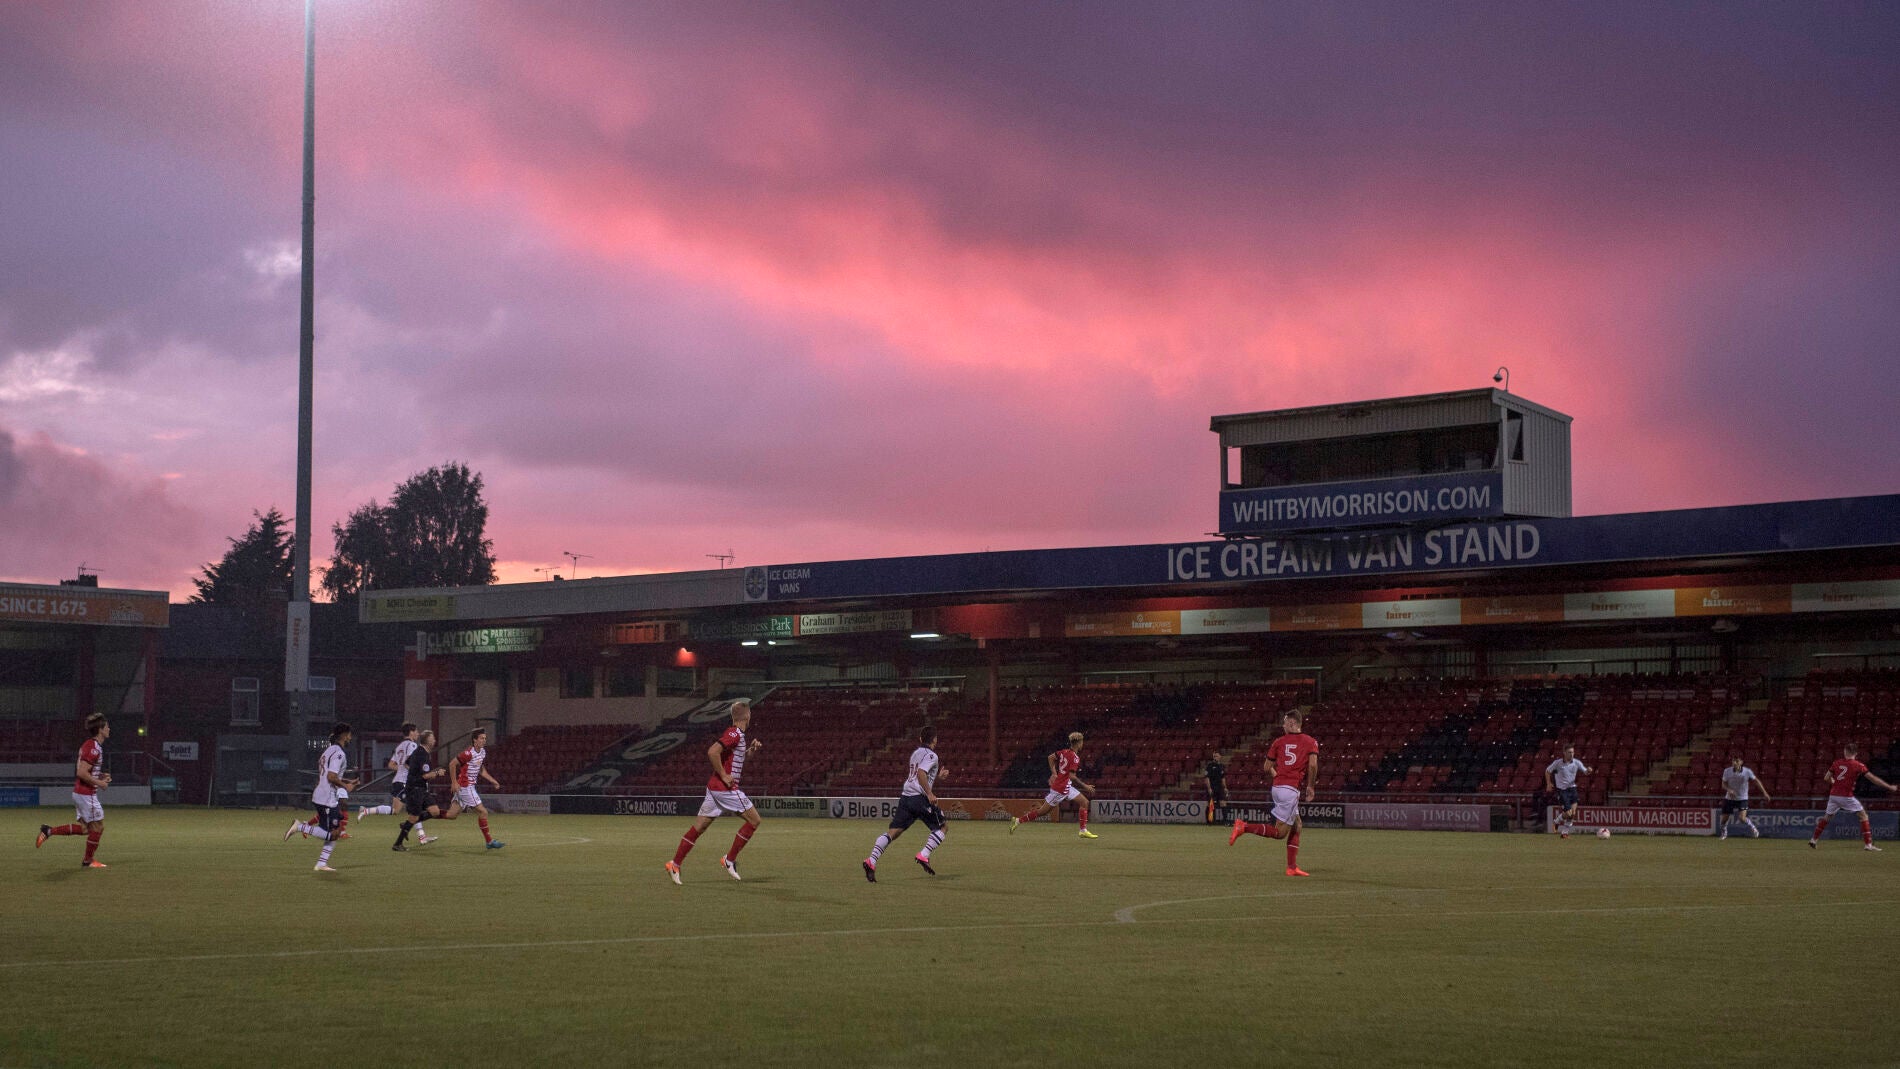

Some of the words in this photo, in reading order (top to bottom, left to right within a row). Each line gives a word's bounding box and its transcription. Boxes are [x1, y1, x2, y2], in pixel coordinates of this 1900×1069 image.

[1232, 486, 1490, 522] WHITBYMORRISON.COM
[1168, 546, 1211, 580] ICE
[1221, 539, 1332, 577] CREAM
[1346, 532, 1412, 569] VAN
[1424, 524, 1540, 566] STAND
[769, 571, 781, 581] ICE
[782, 568, 810, 580] CREAM
[779, 583, 801, 593] VANS
[0, 597, 46, 614] SINCE
[50, 601, 88, 616] 1675
[771, 617, 792, 631] Park
[801, 615, 836, 627] Graham
[427, 630, 489, 647] CLAYTONS
[1284, 743, 1298, 766] 5
[1836, 765, 1848, 781] 2
[634, 801, 655, 814] RADIO
[655, 801, 678, 814] STOKE
[774, 798, 815, 810] Cheshire
[848, 802, 878, 818] Blue
[1098, 802, 1201, 817] MARTIN&CO
[1307, 806, 1343, 818] 664642
[1352, 809, 1408, 821] TIMPSON
[1421, 810, 1480, 822] TIMPSON
[1638, 811, 1710, 826] MARQUEES
[1719, 814, 1822, 827] MRTIN&C
